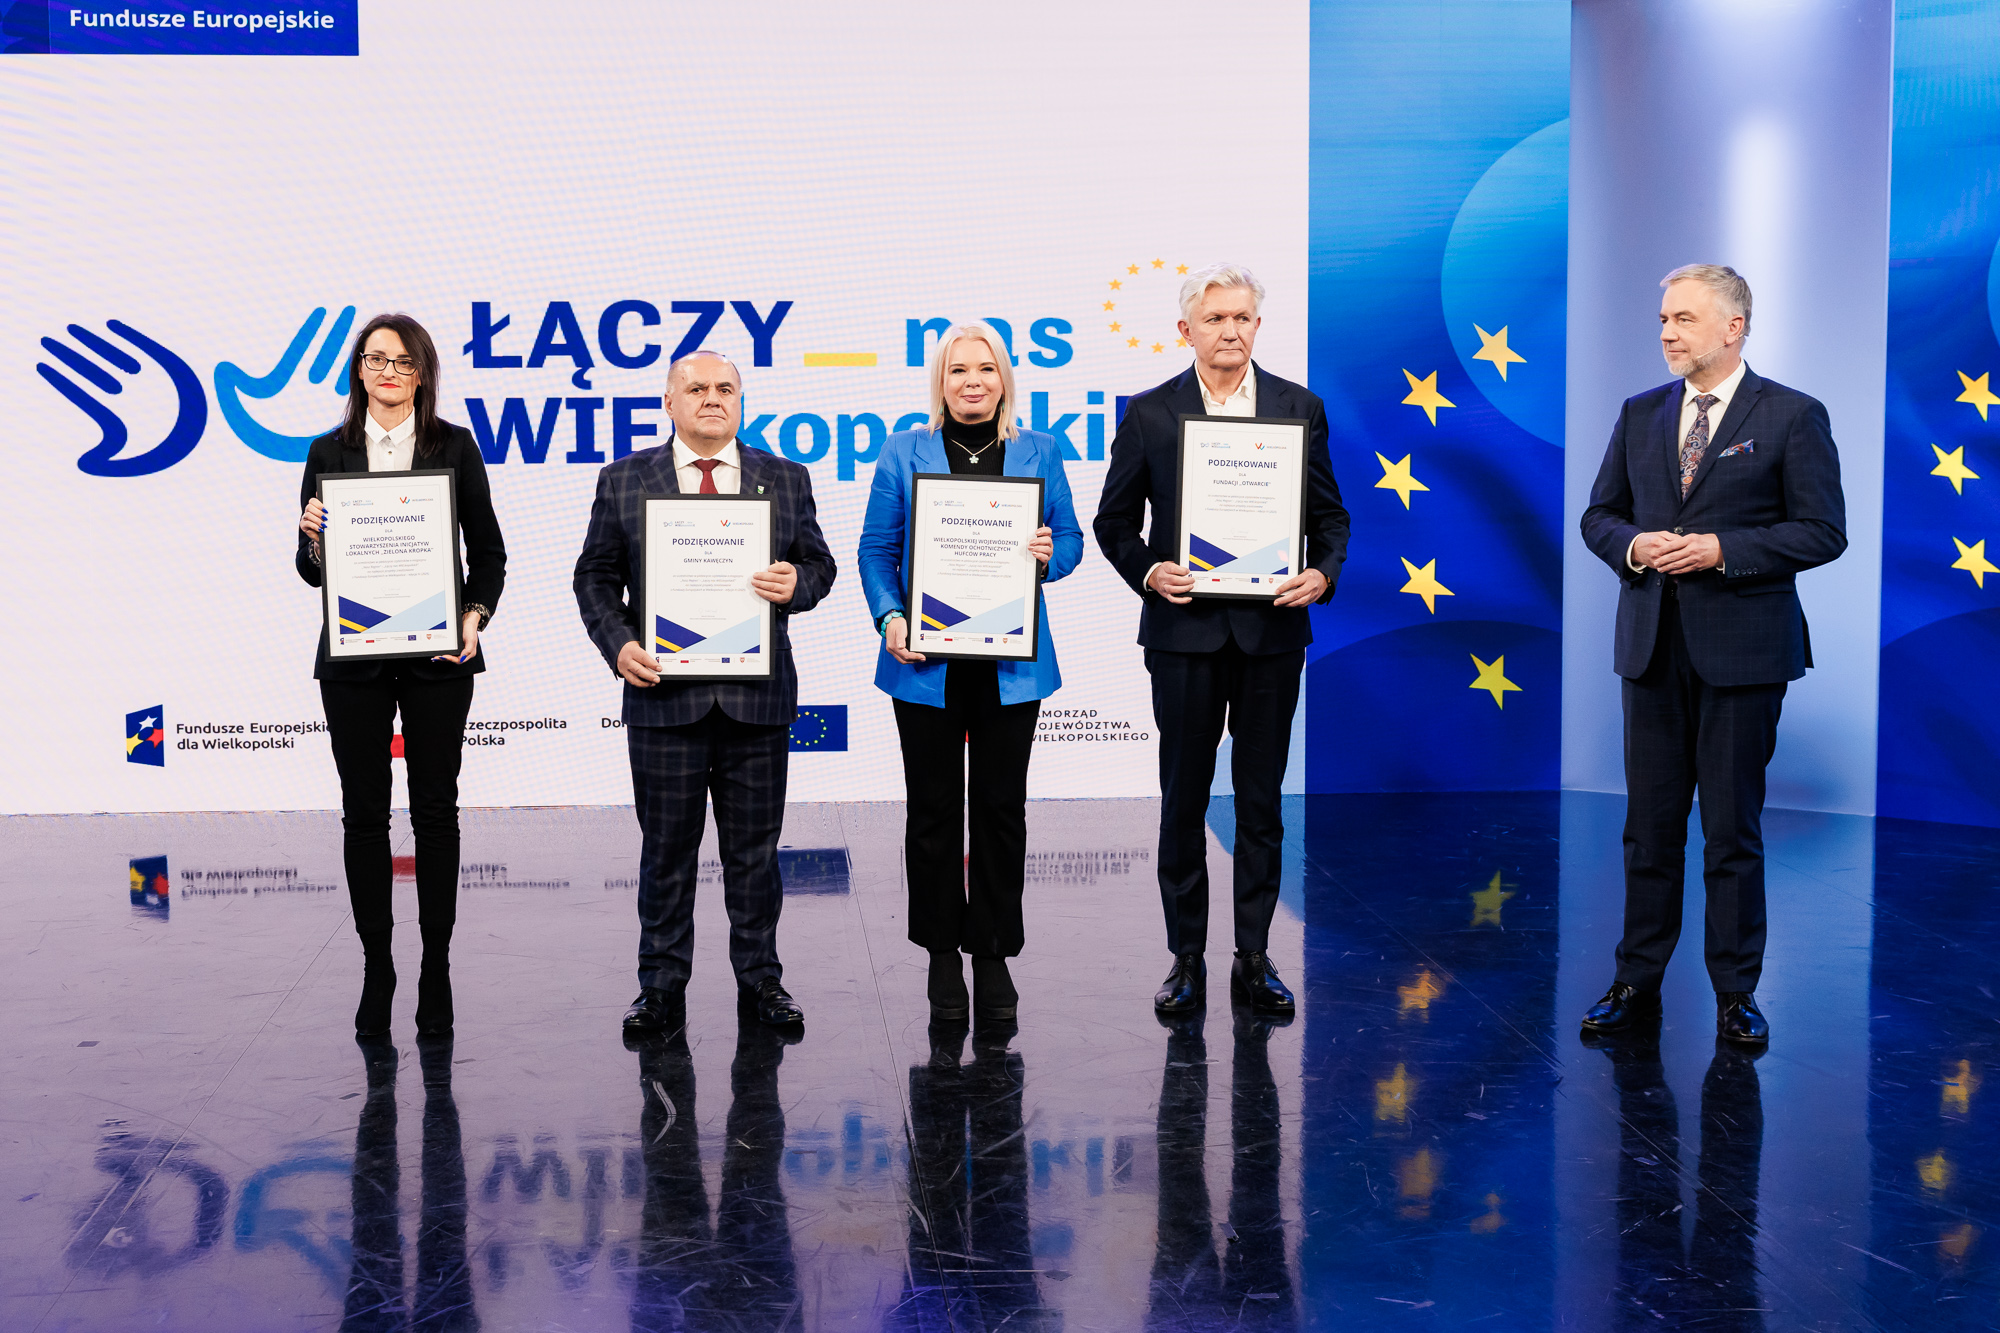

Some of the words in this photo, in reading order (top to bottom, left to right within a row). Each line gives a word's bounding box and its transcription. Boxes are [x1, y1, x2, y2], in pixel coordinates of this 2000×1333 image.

[69, 9, 185, 28] Fundusze
[193, 11, 335, 33] Europejskie
[463, 299, 794, 390] ŁĄCZY
[1208, 459, 1278, 469] PODZIĘKOWANIE
[1213, 479, 1239, 487] FUNDACJI
[351, 514, 425, 525] PODZIĘKOWANIE
[941, 517, 1013, 527] PODZIĘKOWANIE
[672, 538, 745, 547] PODZIĘKOWANIE
[978, 538, 1019, 546] WOJEWÓDZKIEJ
[1038, 710, 1098, 719] MORZĄD
[176, 722, 245, 734] Fundusze
[464, 718, 567, 732] zeczpospolita
[1038, 720, 1131, 730] OJEWÓDZTWA
[177, 738, 199, 750] dla
[202, 737, 295, 751] Wielkopolski
